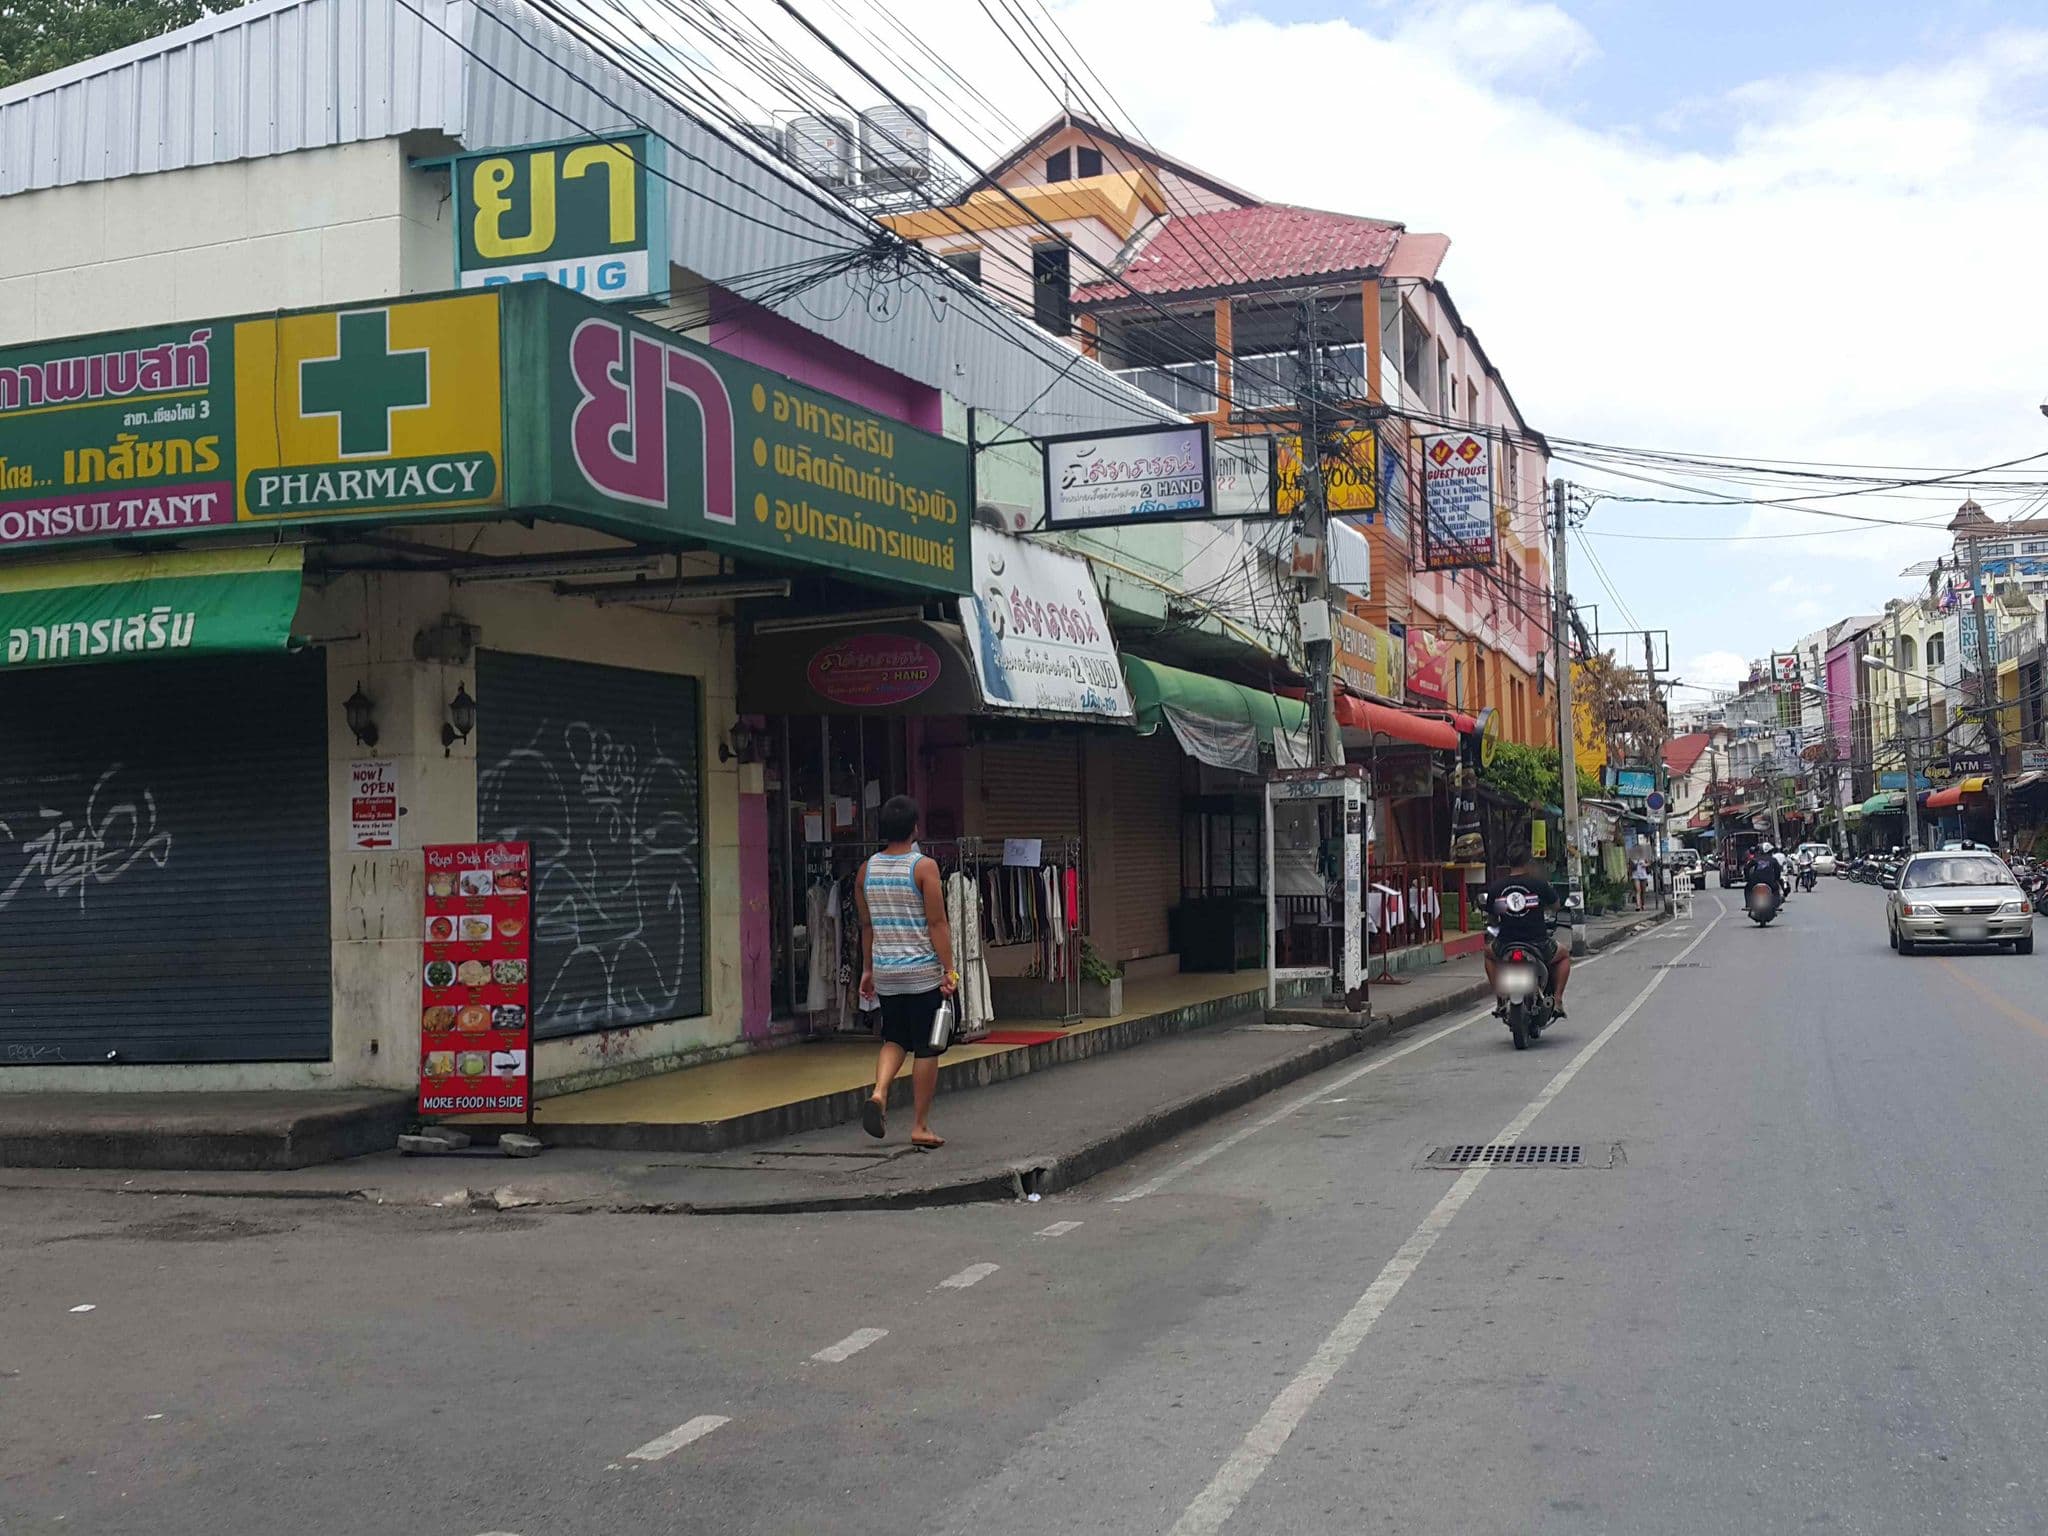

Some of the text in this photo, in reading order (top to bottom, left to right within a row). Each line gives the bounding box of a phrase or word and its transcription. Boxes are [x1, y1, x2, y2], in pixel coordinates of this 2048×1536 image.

[473, 142, 636, 258] ยา
[483, 261, 627, 293] UG
[199, 400, 210, 419] 3
[569, 317, 736, 525] ยา
[772, 389, 895, 460] อาหารเสริม
[63, 432, 220, 486] เภสัชกร
[258, 460, 486, 508] PHARMACY
[1428, 465, 1487, 480] GUEST HOUSE
[1140, 484, 1152, 498] 2
[1157, 479, 1204, 498] HAND
[0, 492, 218, 540] ONSULTANT
[774, 497, 956, 571] อุปกรณ์การแพทย์
[8, 606, 195, 663] อาหารเสริม
[1963, 631, 1996, 647] RIH
[894, 669, 929, 681] HAND
[353, 768, 382, 781] NOW!
[1954, 761, 1979, 772] ATM
[361, 782, 394, 796] OPEN
[423, 1095, 523, 1109] MORE FOOD IN SIDE
